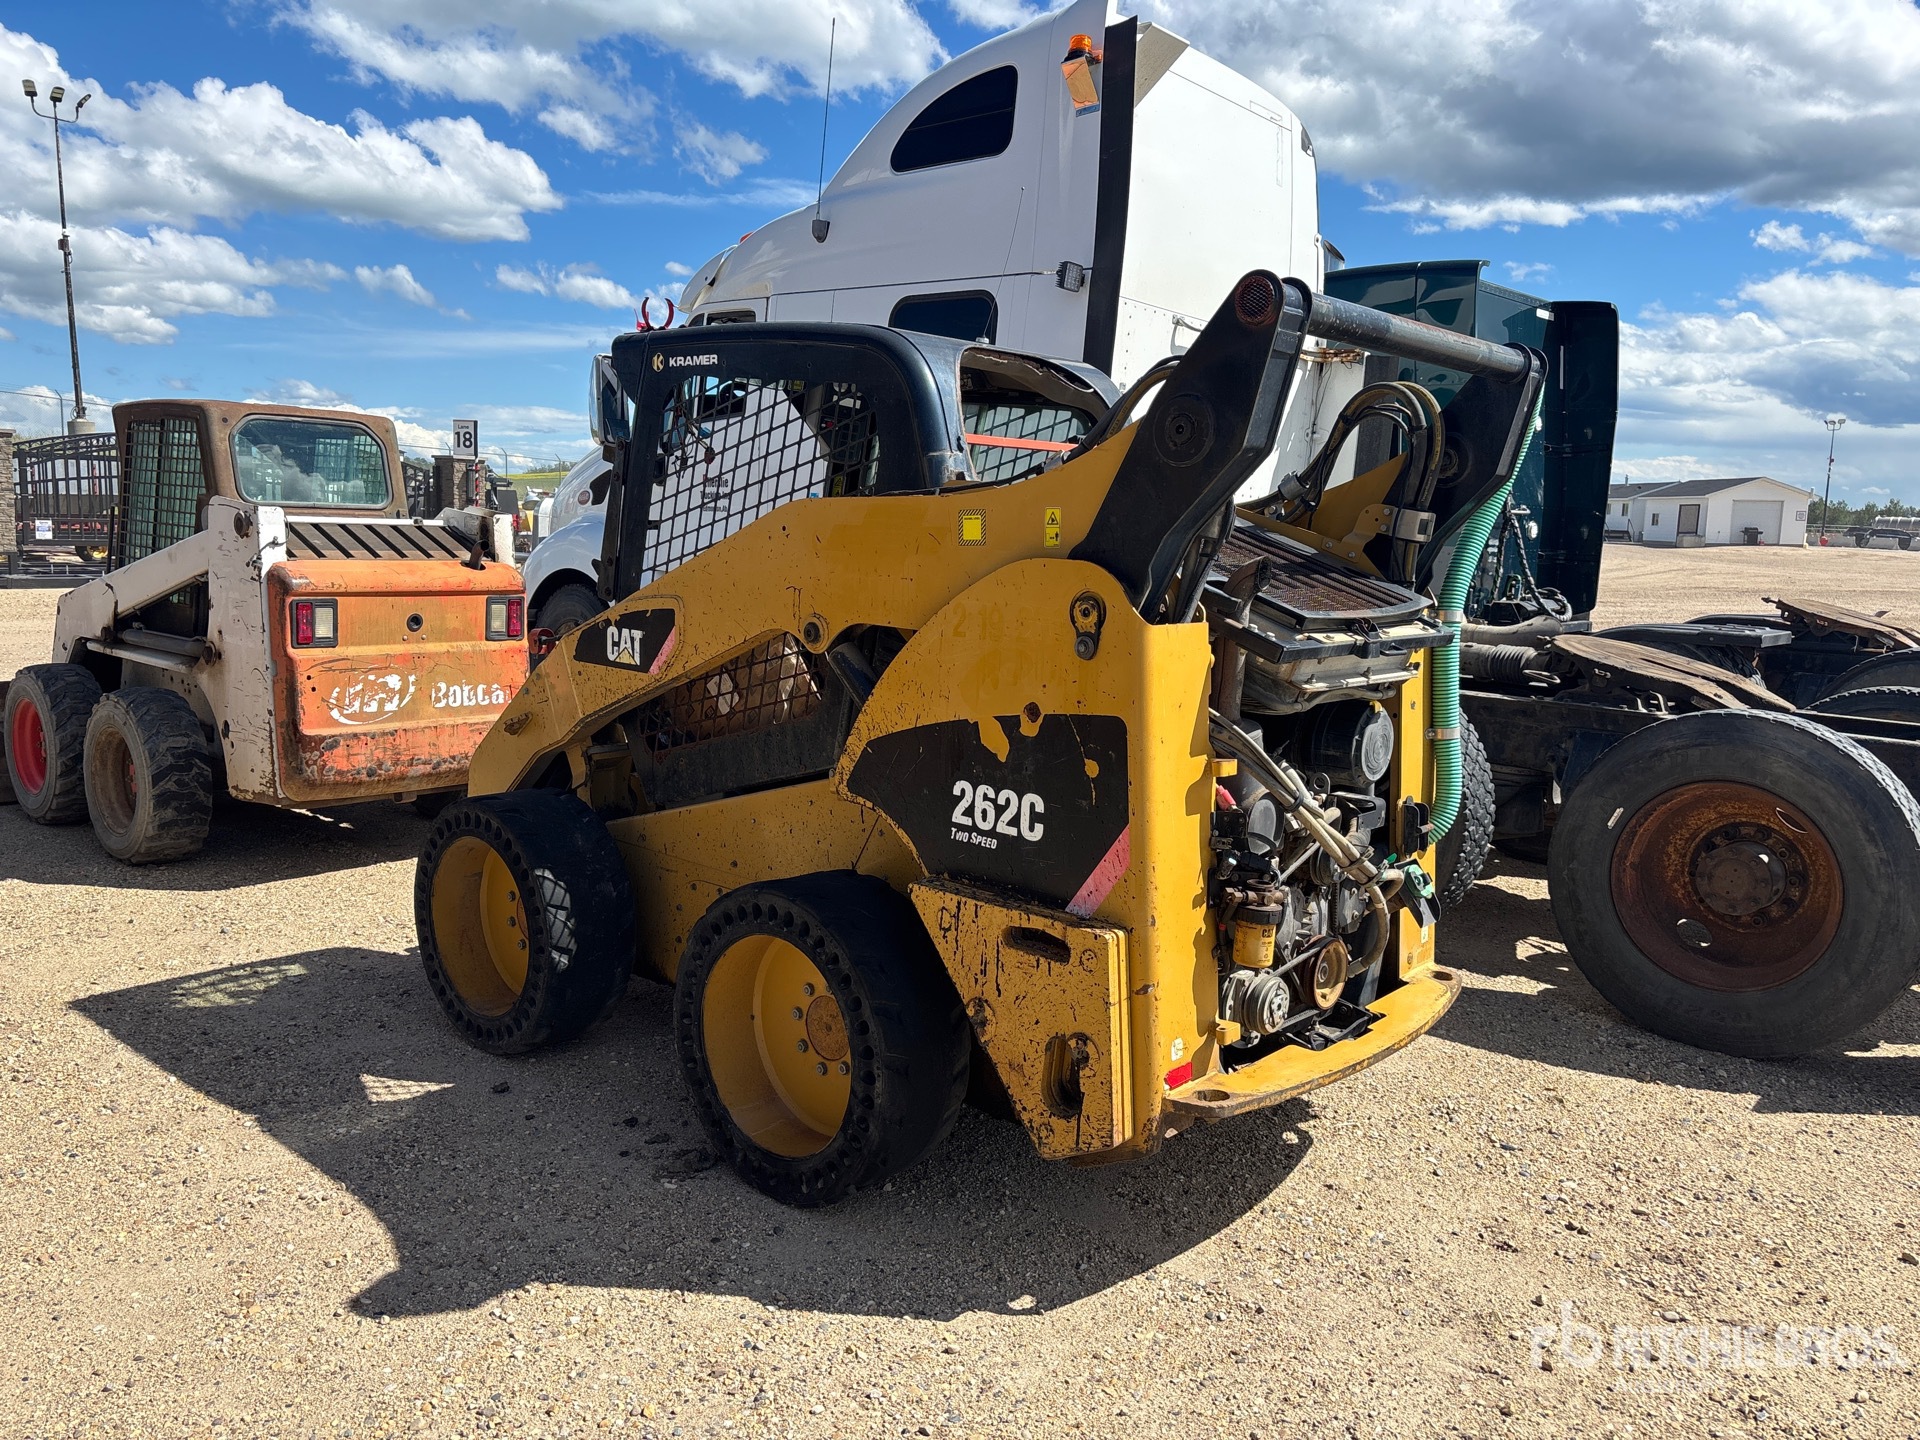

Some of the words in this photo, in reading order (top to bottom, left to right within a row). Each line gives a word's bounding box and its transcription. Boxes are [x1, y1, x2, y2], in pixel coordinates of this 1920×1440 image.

[669, 354, 718, 367] KRAMER
[455, 431, 473, 449] 18
[606, 625, 642, 666] CAT
[951, 780, 1045, 842] 262C
